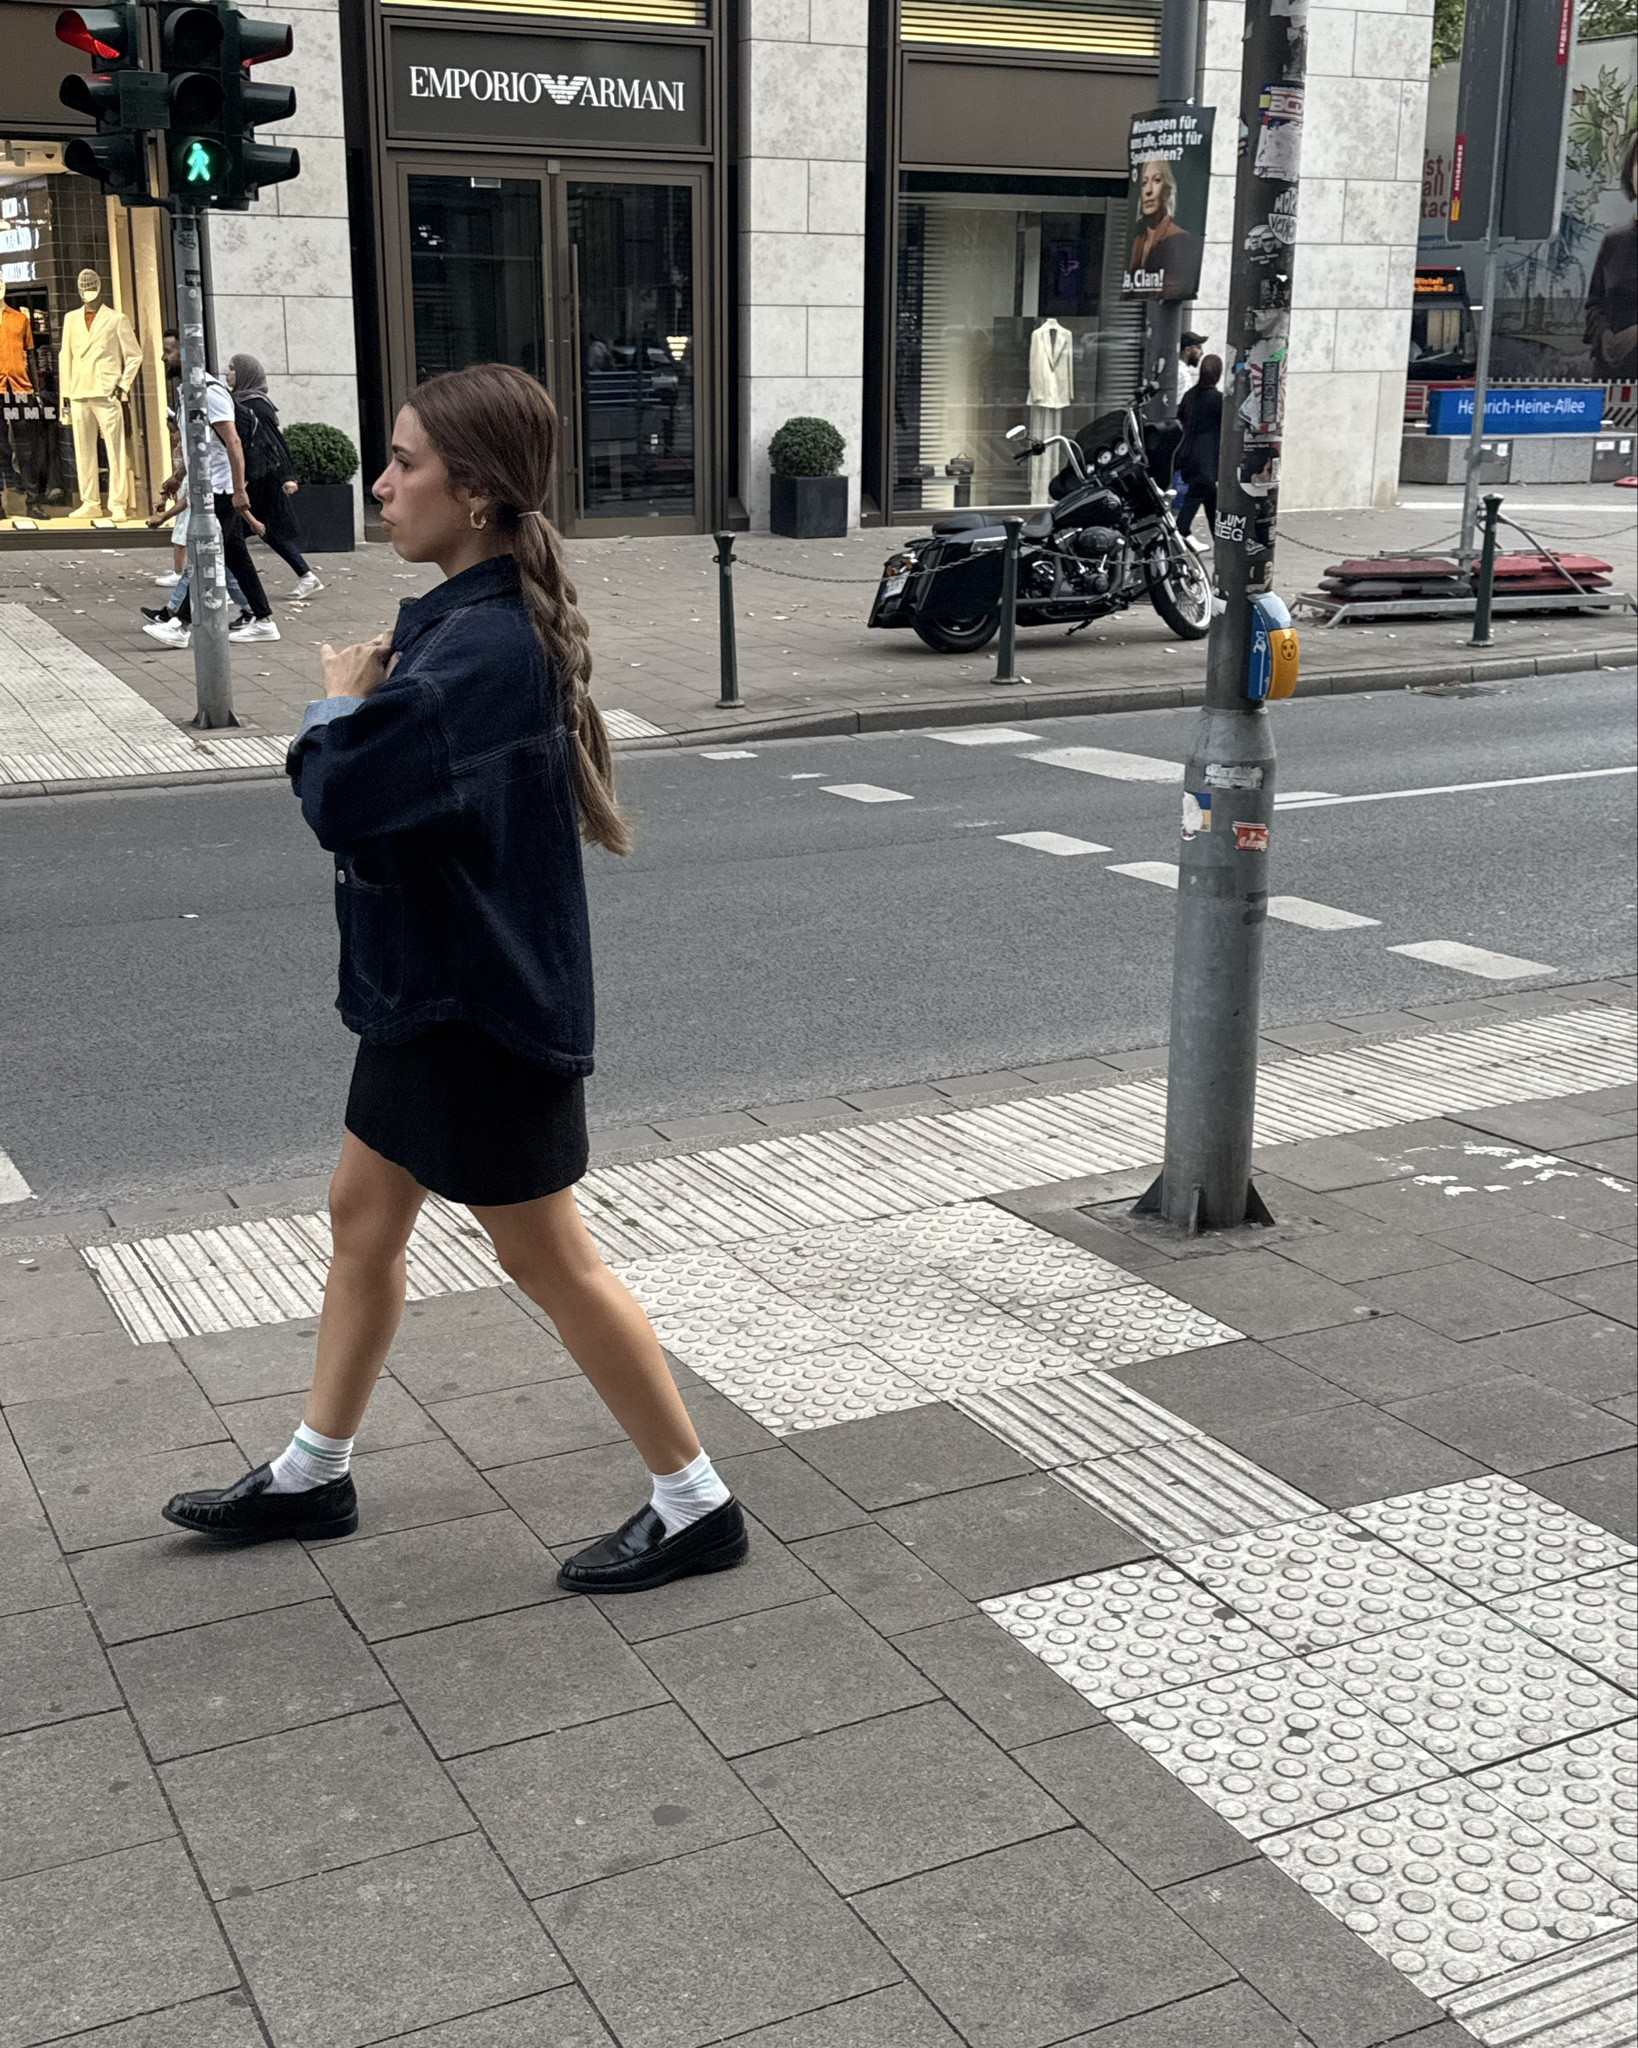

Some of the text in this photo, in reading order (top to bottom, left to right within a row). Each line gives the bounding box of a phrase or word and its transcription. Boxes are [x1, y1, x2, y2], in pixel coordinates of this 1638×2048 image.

[409, 66, 685, 111] EMPORIO ARMANI
[1179, 115, 1198, 130] für
[1157, 131, 1183, 145] statt
[1185, 130, 1203, 145] für
[1134, 269, 1164, 287] Clara!
